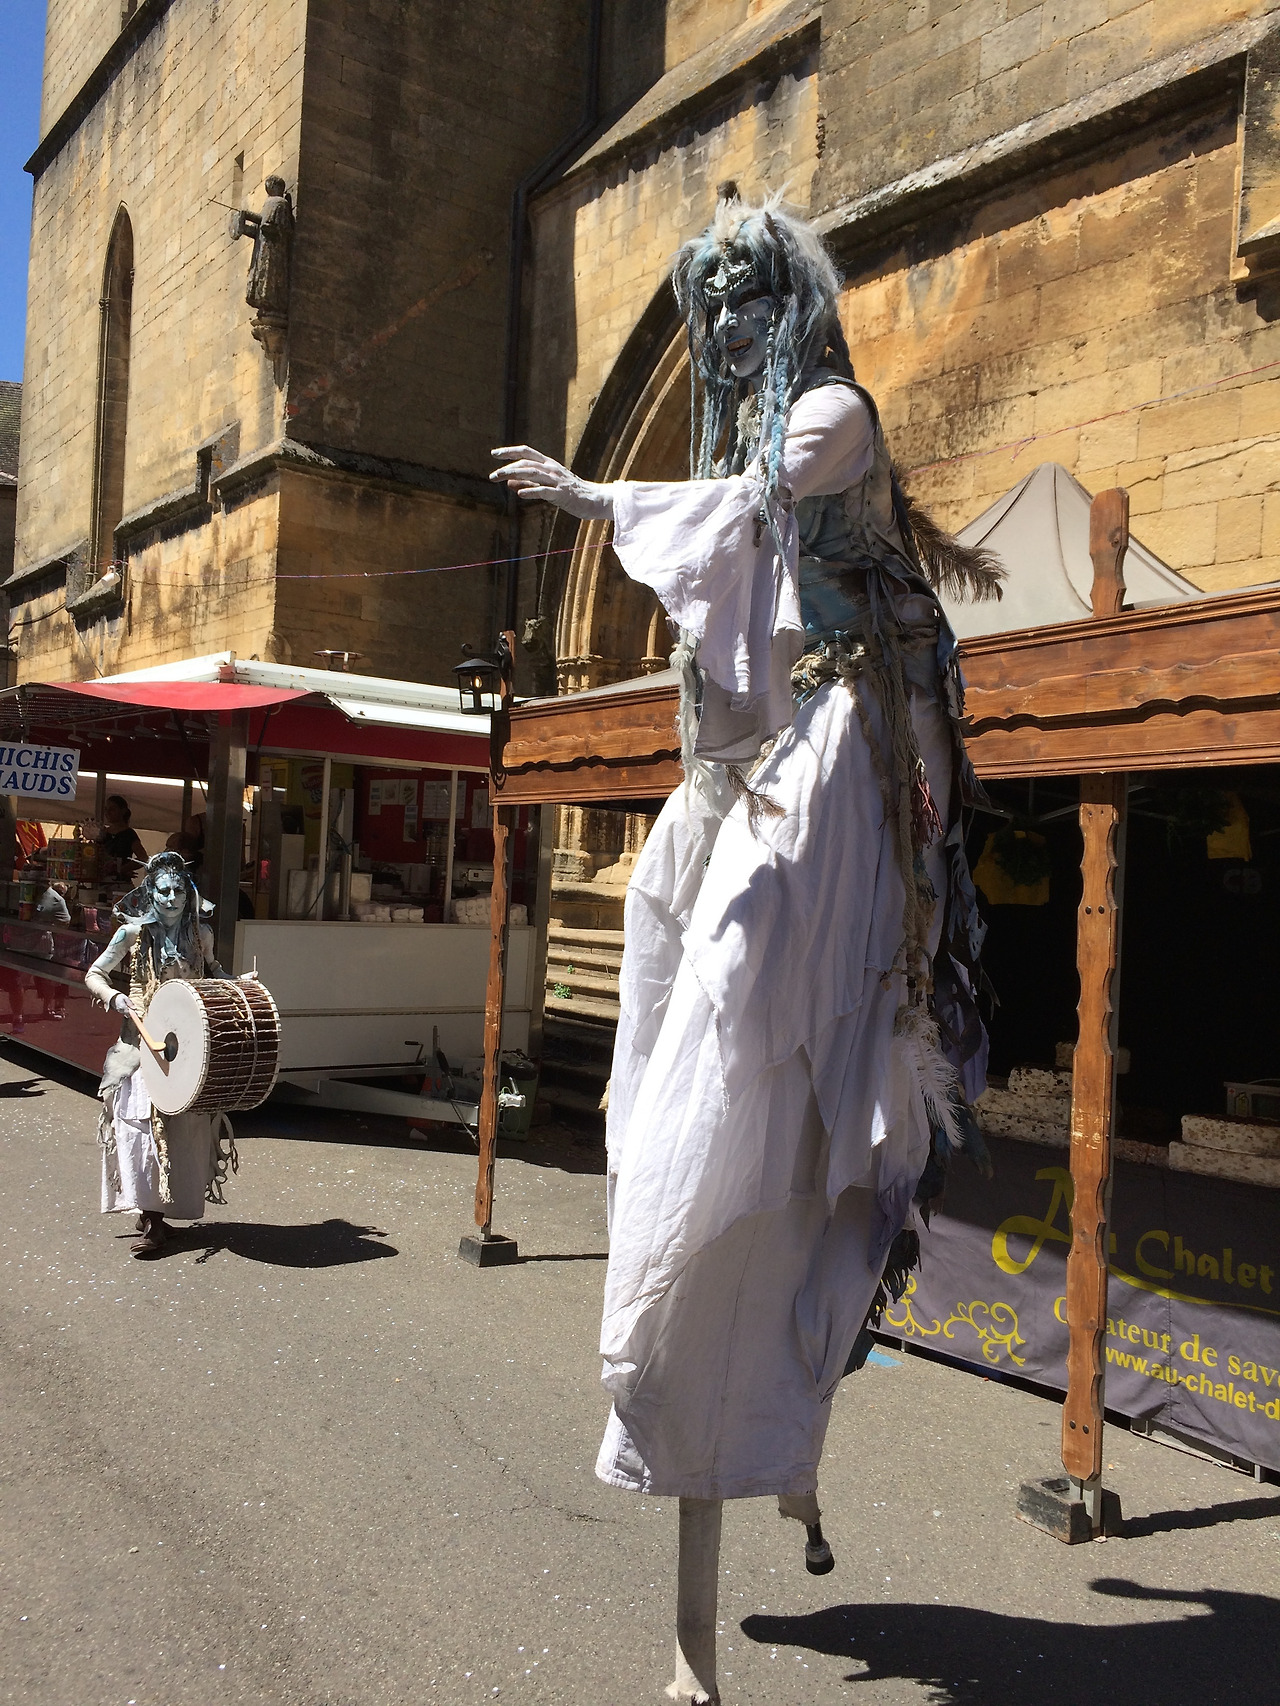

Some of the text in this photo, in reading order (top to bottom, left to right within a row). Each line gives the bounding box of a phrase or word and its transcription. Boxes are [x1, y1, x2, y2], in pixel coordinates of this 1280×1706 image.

[0, 769, 72, 795] AUDS
[991, 1166, 1276, 1294] A Chalet
[1179, 1333, 1219, 1367] de
[1227, 1354, 1280, 1388] sav
